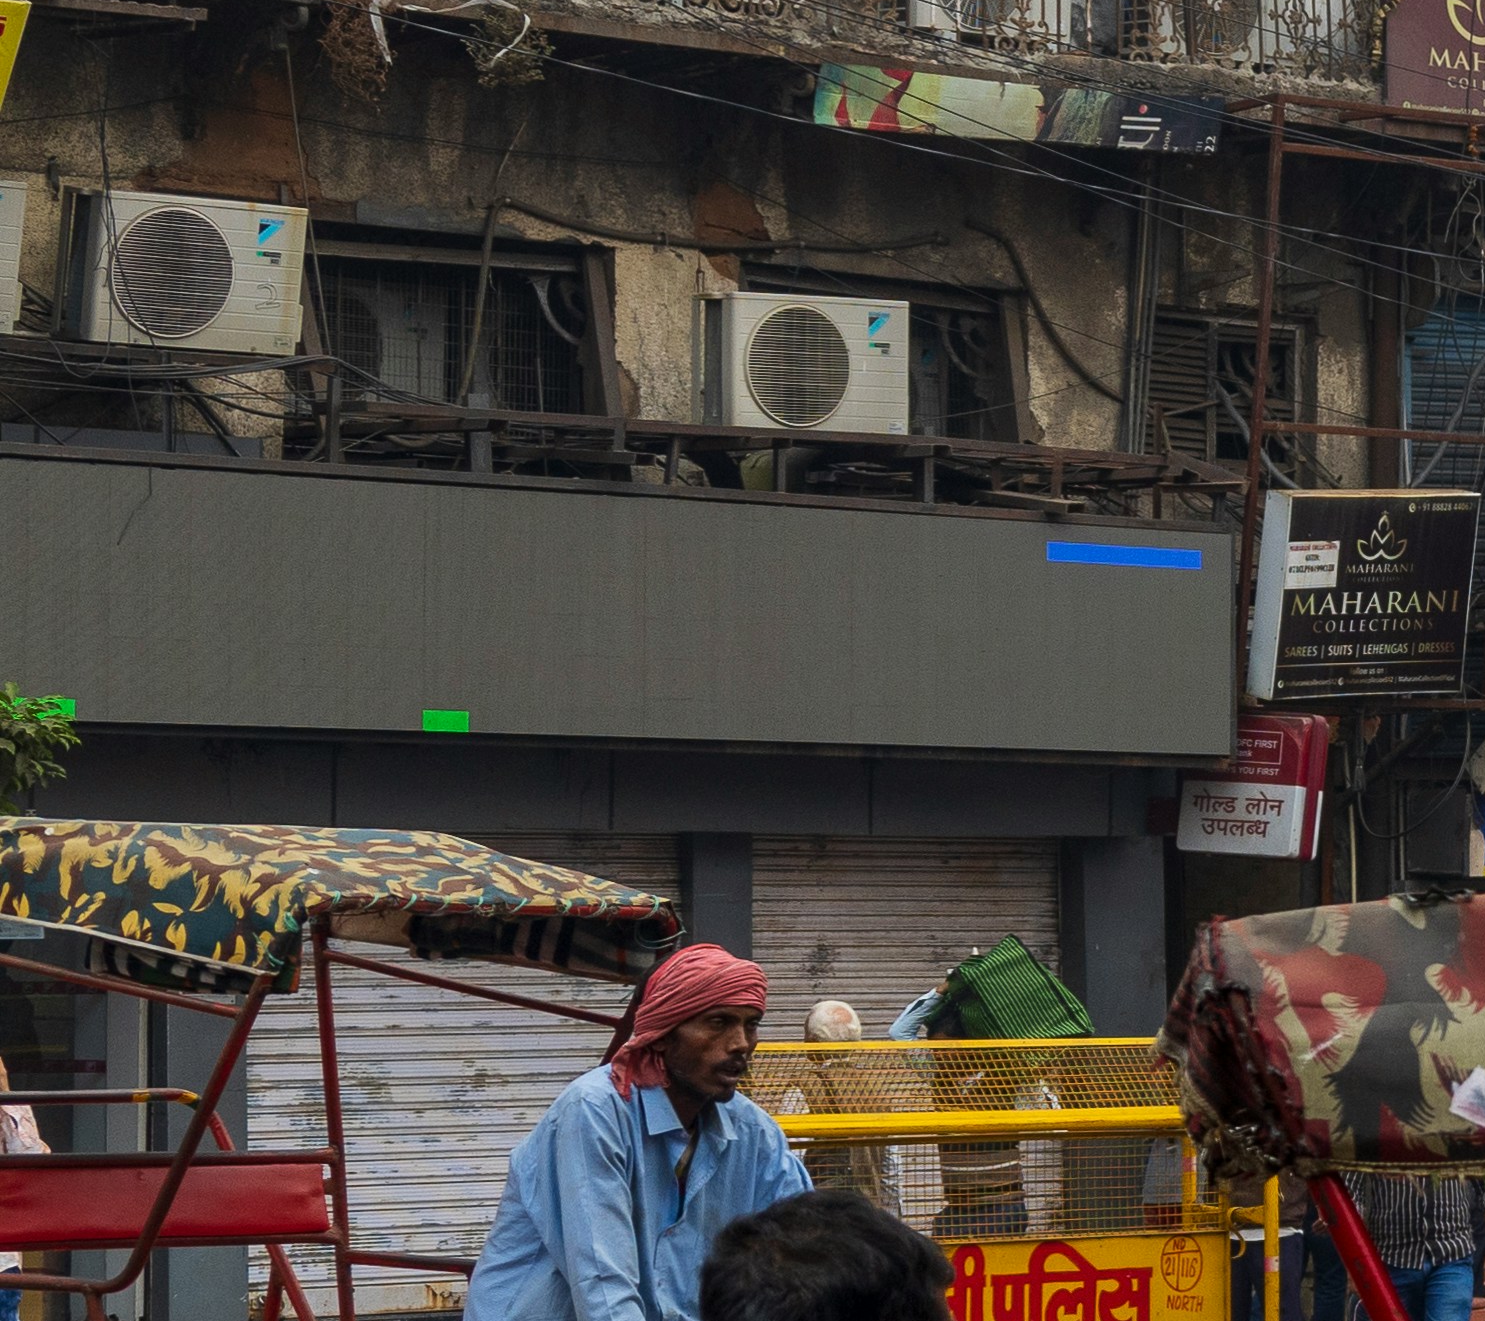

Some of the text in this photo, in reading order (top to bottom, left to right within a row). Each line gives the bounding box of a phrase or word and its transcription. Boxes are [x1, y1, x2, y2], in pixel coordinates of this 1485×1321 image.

[1346, 563, 1415, 574] MAHARANI
[1290, 589, 1459, 617] MAHARANI
[1312, 617, 1434, 634] COLLECTIONS
[1284, 642, 1456, 658] SAREES SUITS LEHENGAS DRESSES
[1254, 739, 1279, 750] FIRST
[1193, 787, 1285, 817] गोल्ड लोन
[1201, 818, 1270, 838] उपलब्ध
[1173, 1238, 1187, 1251] ND
[1166, 1294, 1204, 1312] NORTH
